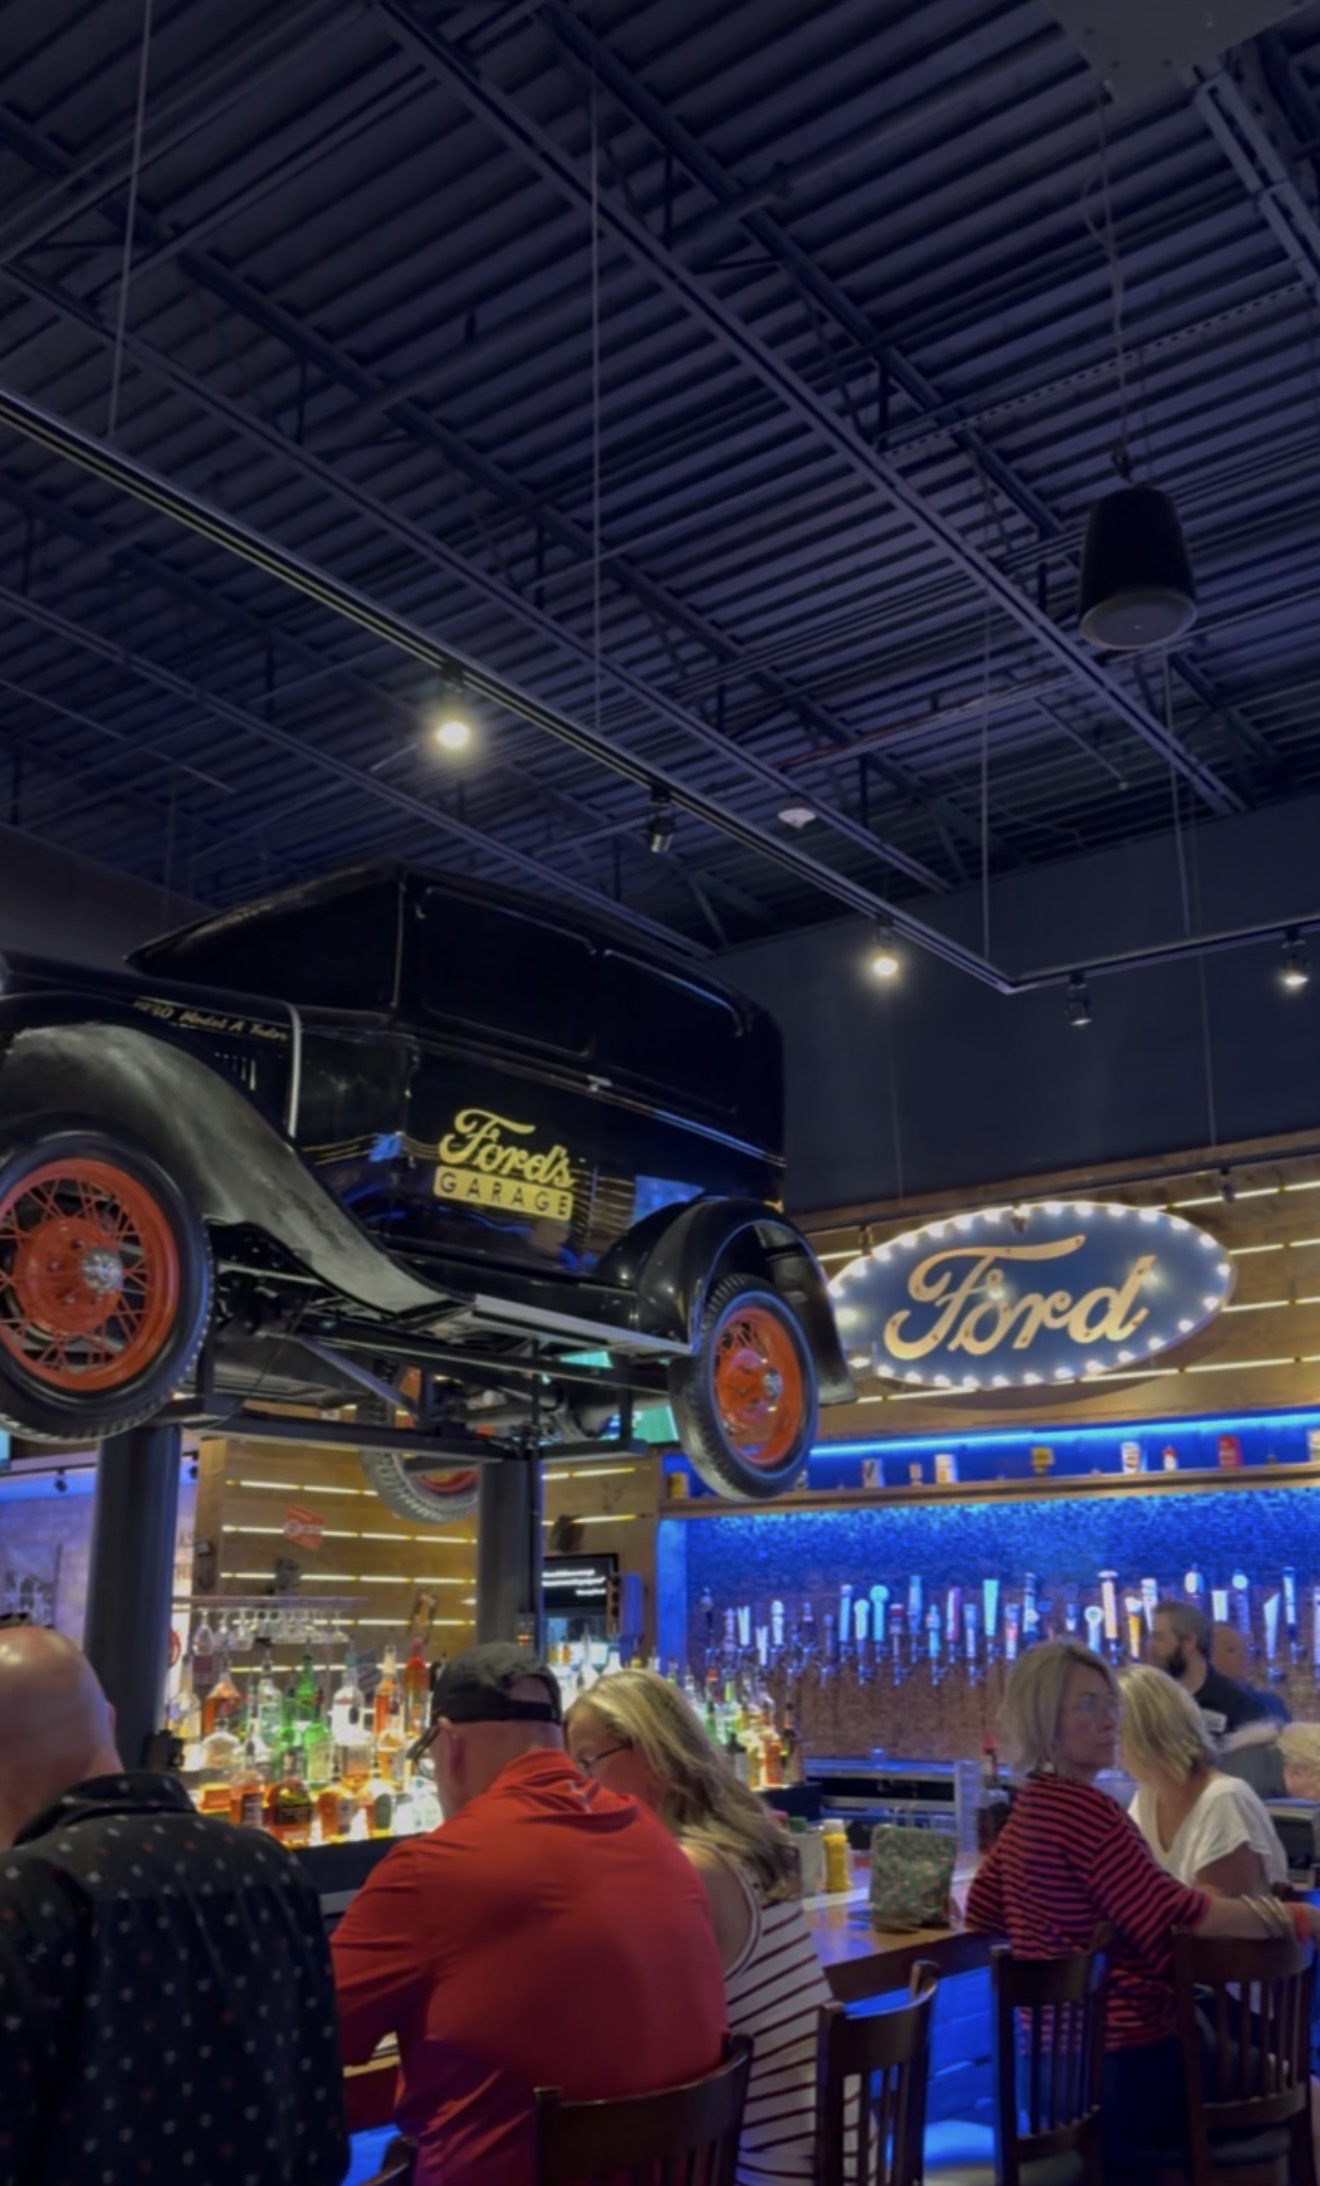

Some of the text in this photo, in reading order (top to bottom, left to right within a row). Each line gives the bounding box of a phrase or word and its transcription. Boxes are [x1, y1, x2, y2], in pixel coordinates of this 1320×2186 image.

[228, 1021, 246, 1032] A
[439, 1108, 574, 1188] Ford's
[439, 1172, 567, 1216] GARAGE
[884, 1234, 1156, 1360] Ford
